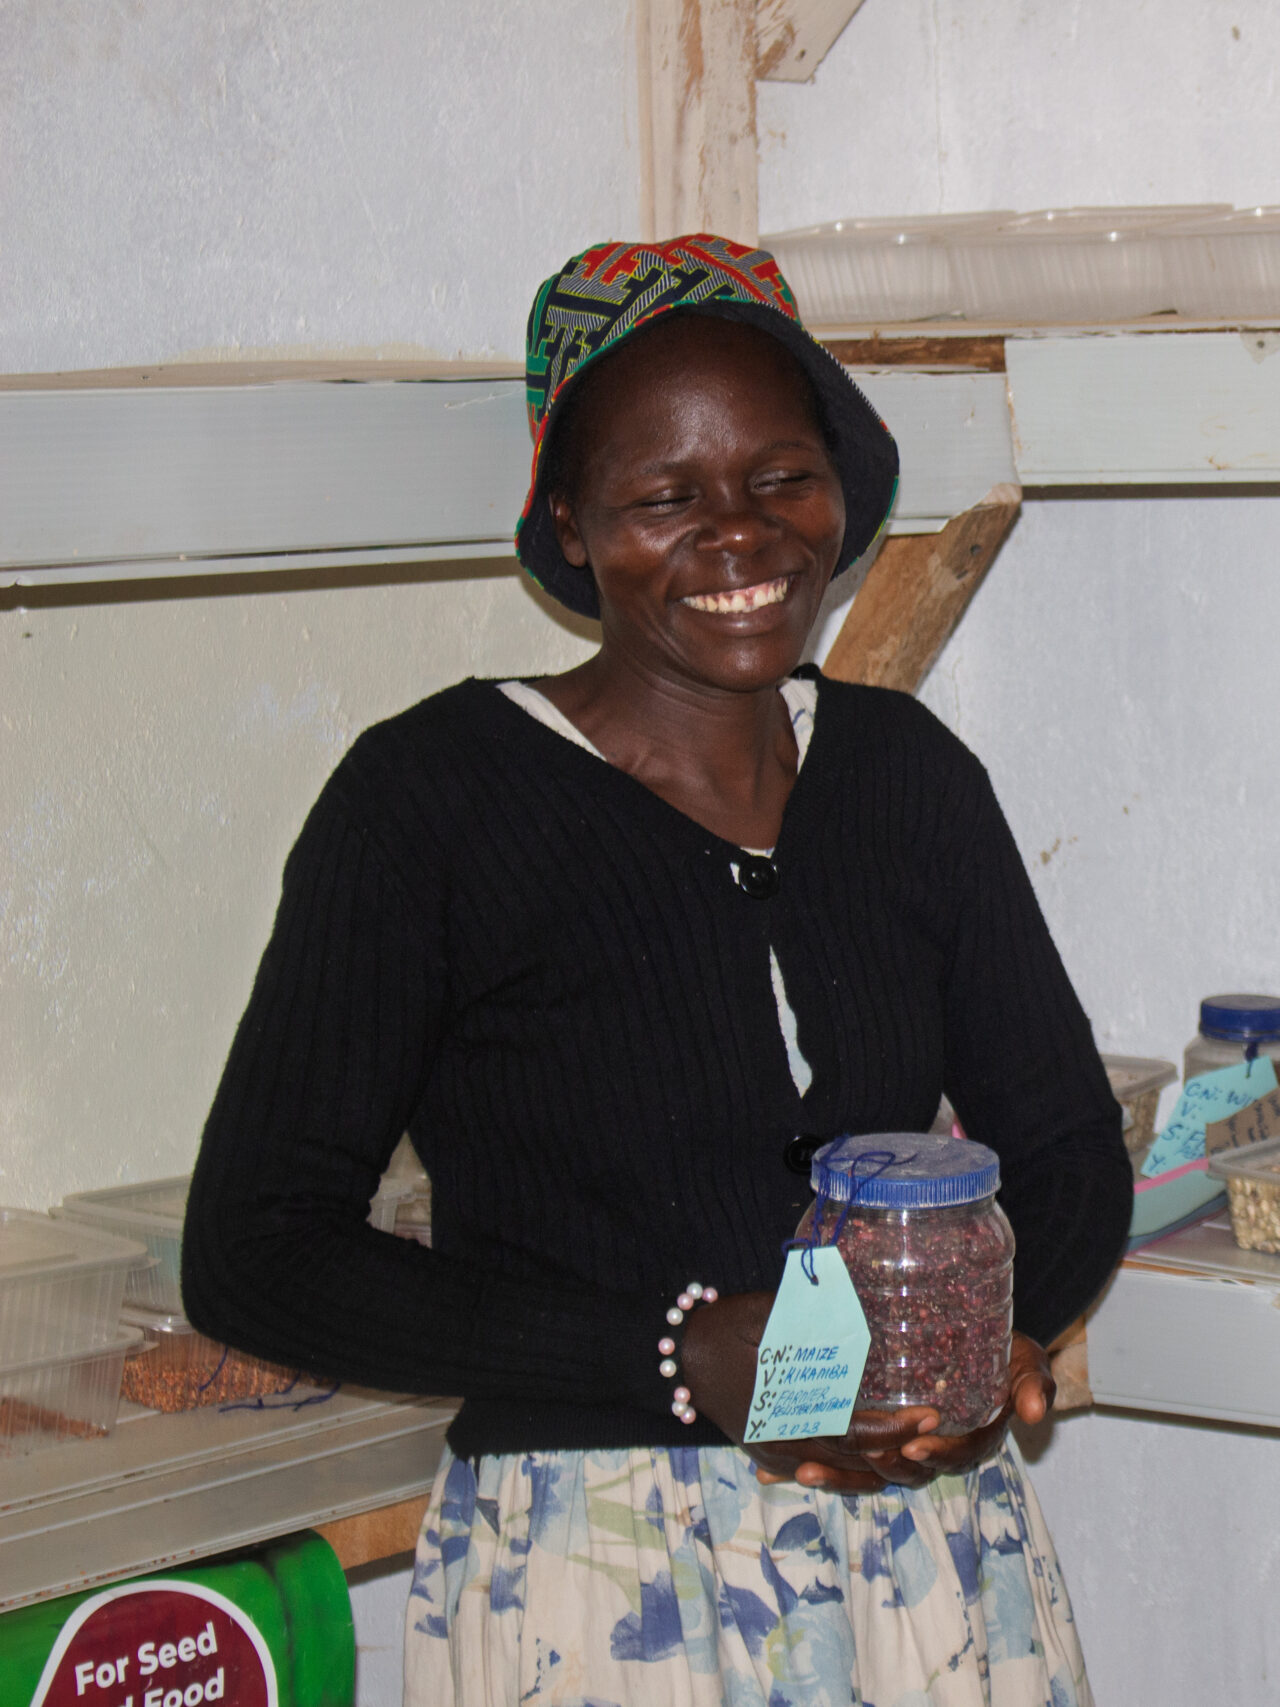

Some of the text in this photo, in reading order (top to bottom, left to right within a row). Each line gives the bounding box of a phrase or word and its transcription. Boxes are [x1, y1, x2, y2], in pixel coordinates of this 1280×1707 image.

[794, 1345, 840, 1362] MAIZE
[784, 1364, 849, 1385] KIKAMBA
[777, 1421, 821, 1437] 2023
[75, 1620, 218, 1697] For Seed
[144, 1667, 225, 1707] Food
